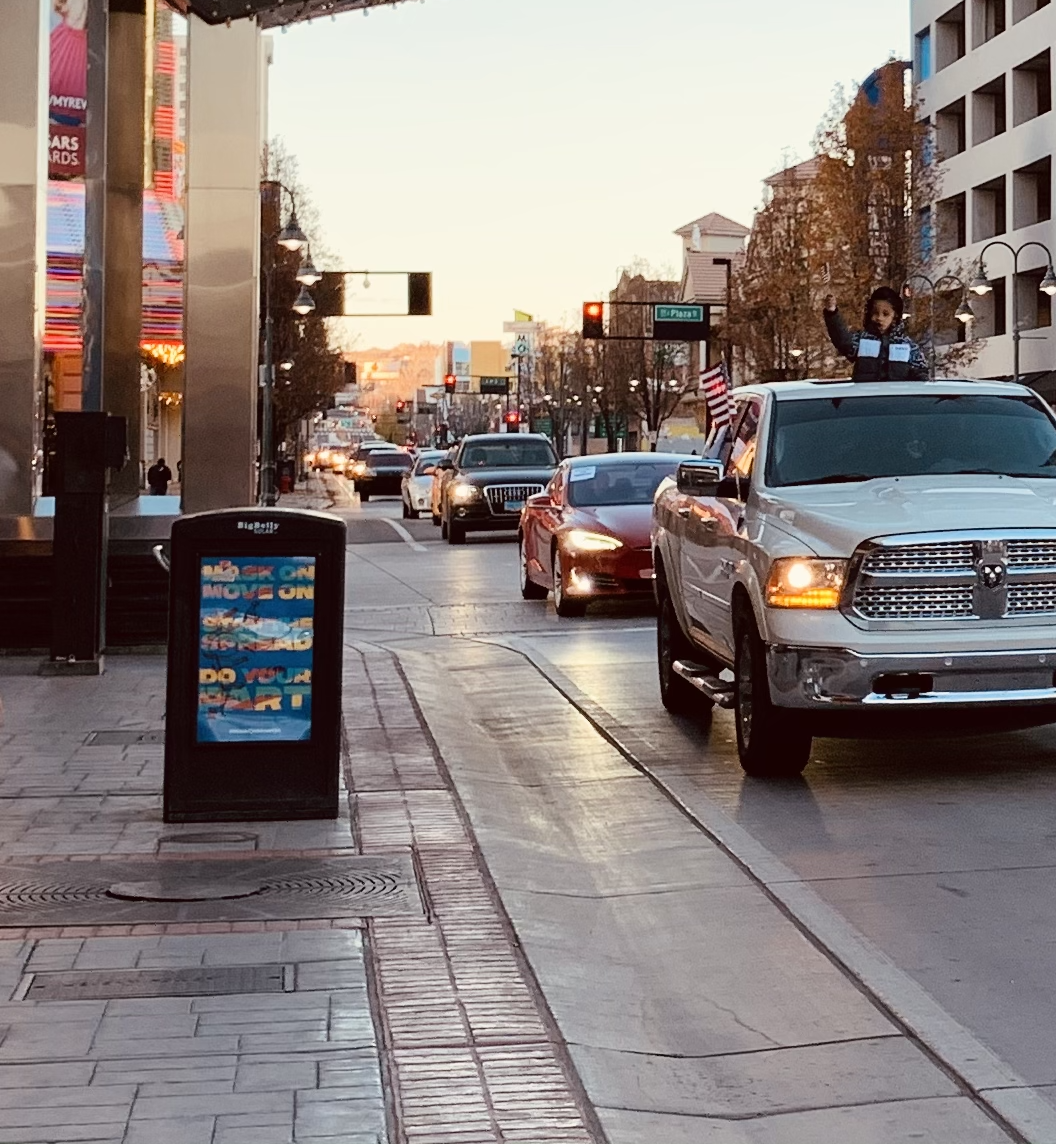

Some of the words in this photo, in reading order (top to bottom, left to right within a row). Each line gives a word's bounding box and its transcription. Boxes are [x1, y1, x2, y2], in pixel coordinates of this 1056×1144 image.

[237, 521, 280, 531] BigBelly
[201, 564, 276, 582] MASK
[279, 564, 316, 582] ON
[202, 583, 274, 600] MOVE
[278, 583, 315, 600] ON
[199, 667, 237, 684] DO
[240, 667, 312, 684] YOUR
[198, 685, 312, 712] PART
